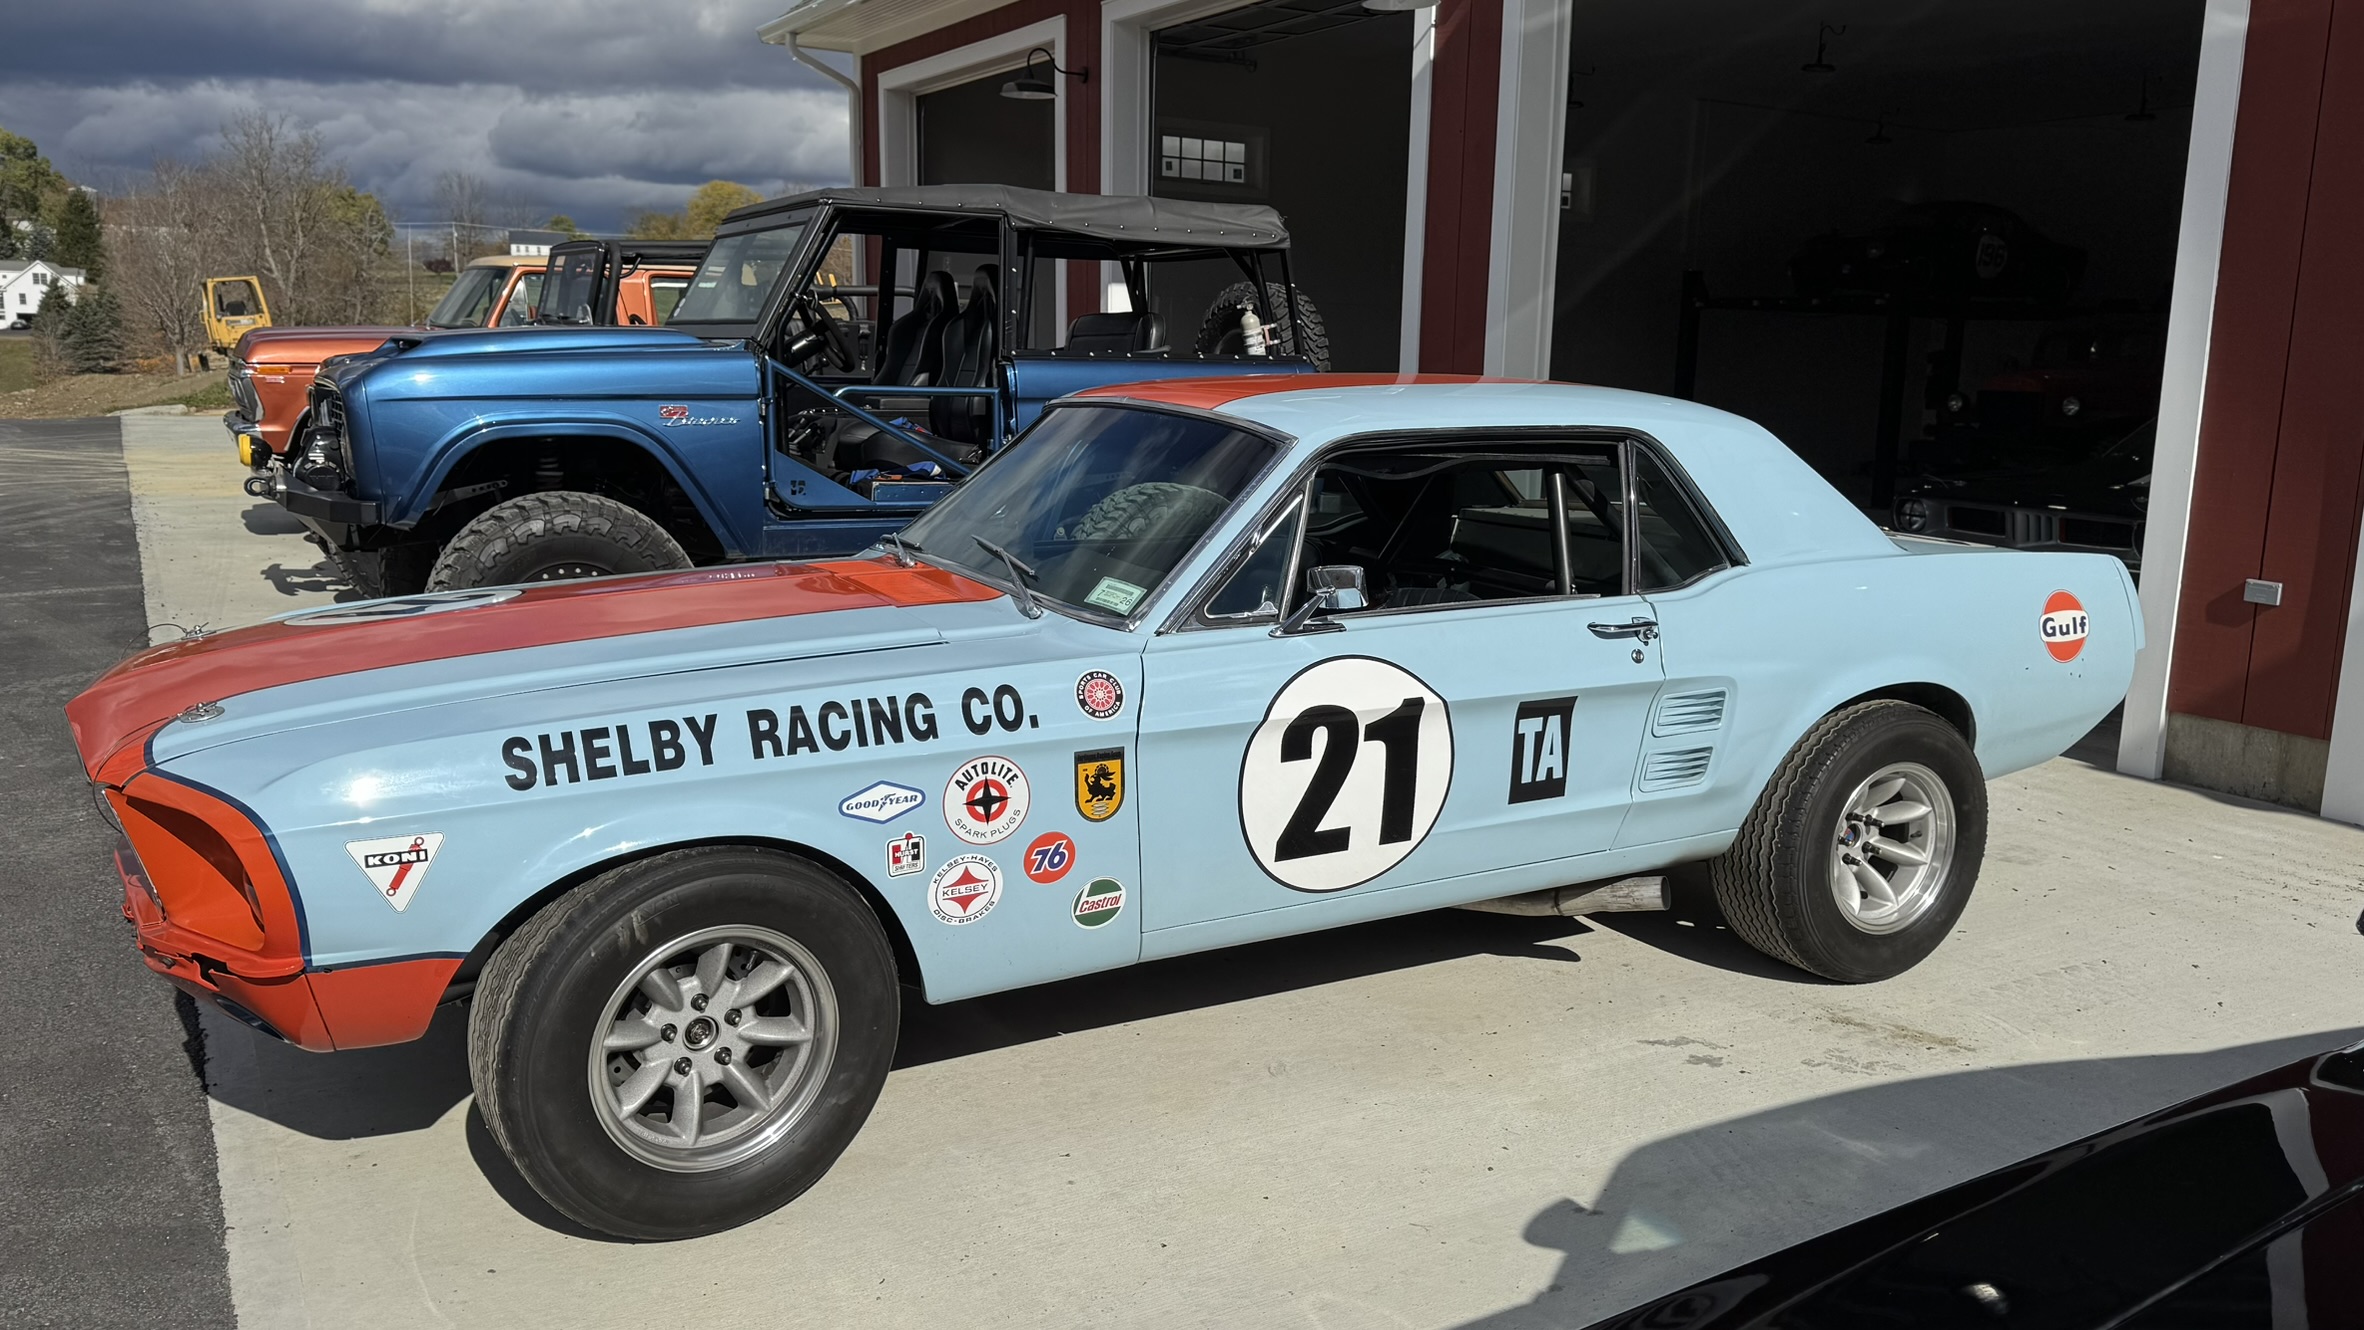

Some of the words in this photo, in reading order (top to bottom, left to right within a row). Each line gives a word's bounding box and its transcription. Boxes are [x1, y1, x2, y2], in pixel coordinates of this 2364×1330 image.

[1119, 596, 1133, 607] 26
[2042, 615, 2088, 638] Gulf
[1078, 674, 1092, 700] SPORTS
[1109, 677, 1122, 695] CLUB
[1084, 705, 1094, 713] OF
[1094, 701, 1120, 717] AMERICA
[502, 714, 718, 790] SHELBY
[747, 693, 939, 760] RACING
[962, 685, 1039, 736] CO.
[1517, 714, 1563, 784] TA
[1275, 697, 1425, 862] 21
[846, 792, 918, 812] GOODYEAR
[954, 818, 988, 839] SPARK
[990, 809, 1021, 838] PLUGS
[367, 850, 426, 866] KONI
[894, 848, 919, 858] HURST
[1031, 840, 1067, 873] 76
[894, 863, 919, 872] SHIFTERS
[942, 883, 988, 897] KELSEY
[1079, 893, 1122, 913] Castrol
